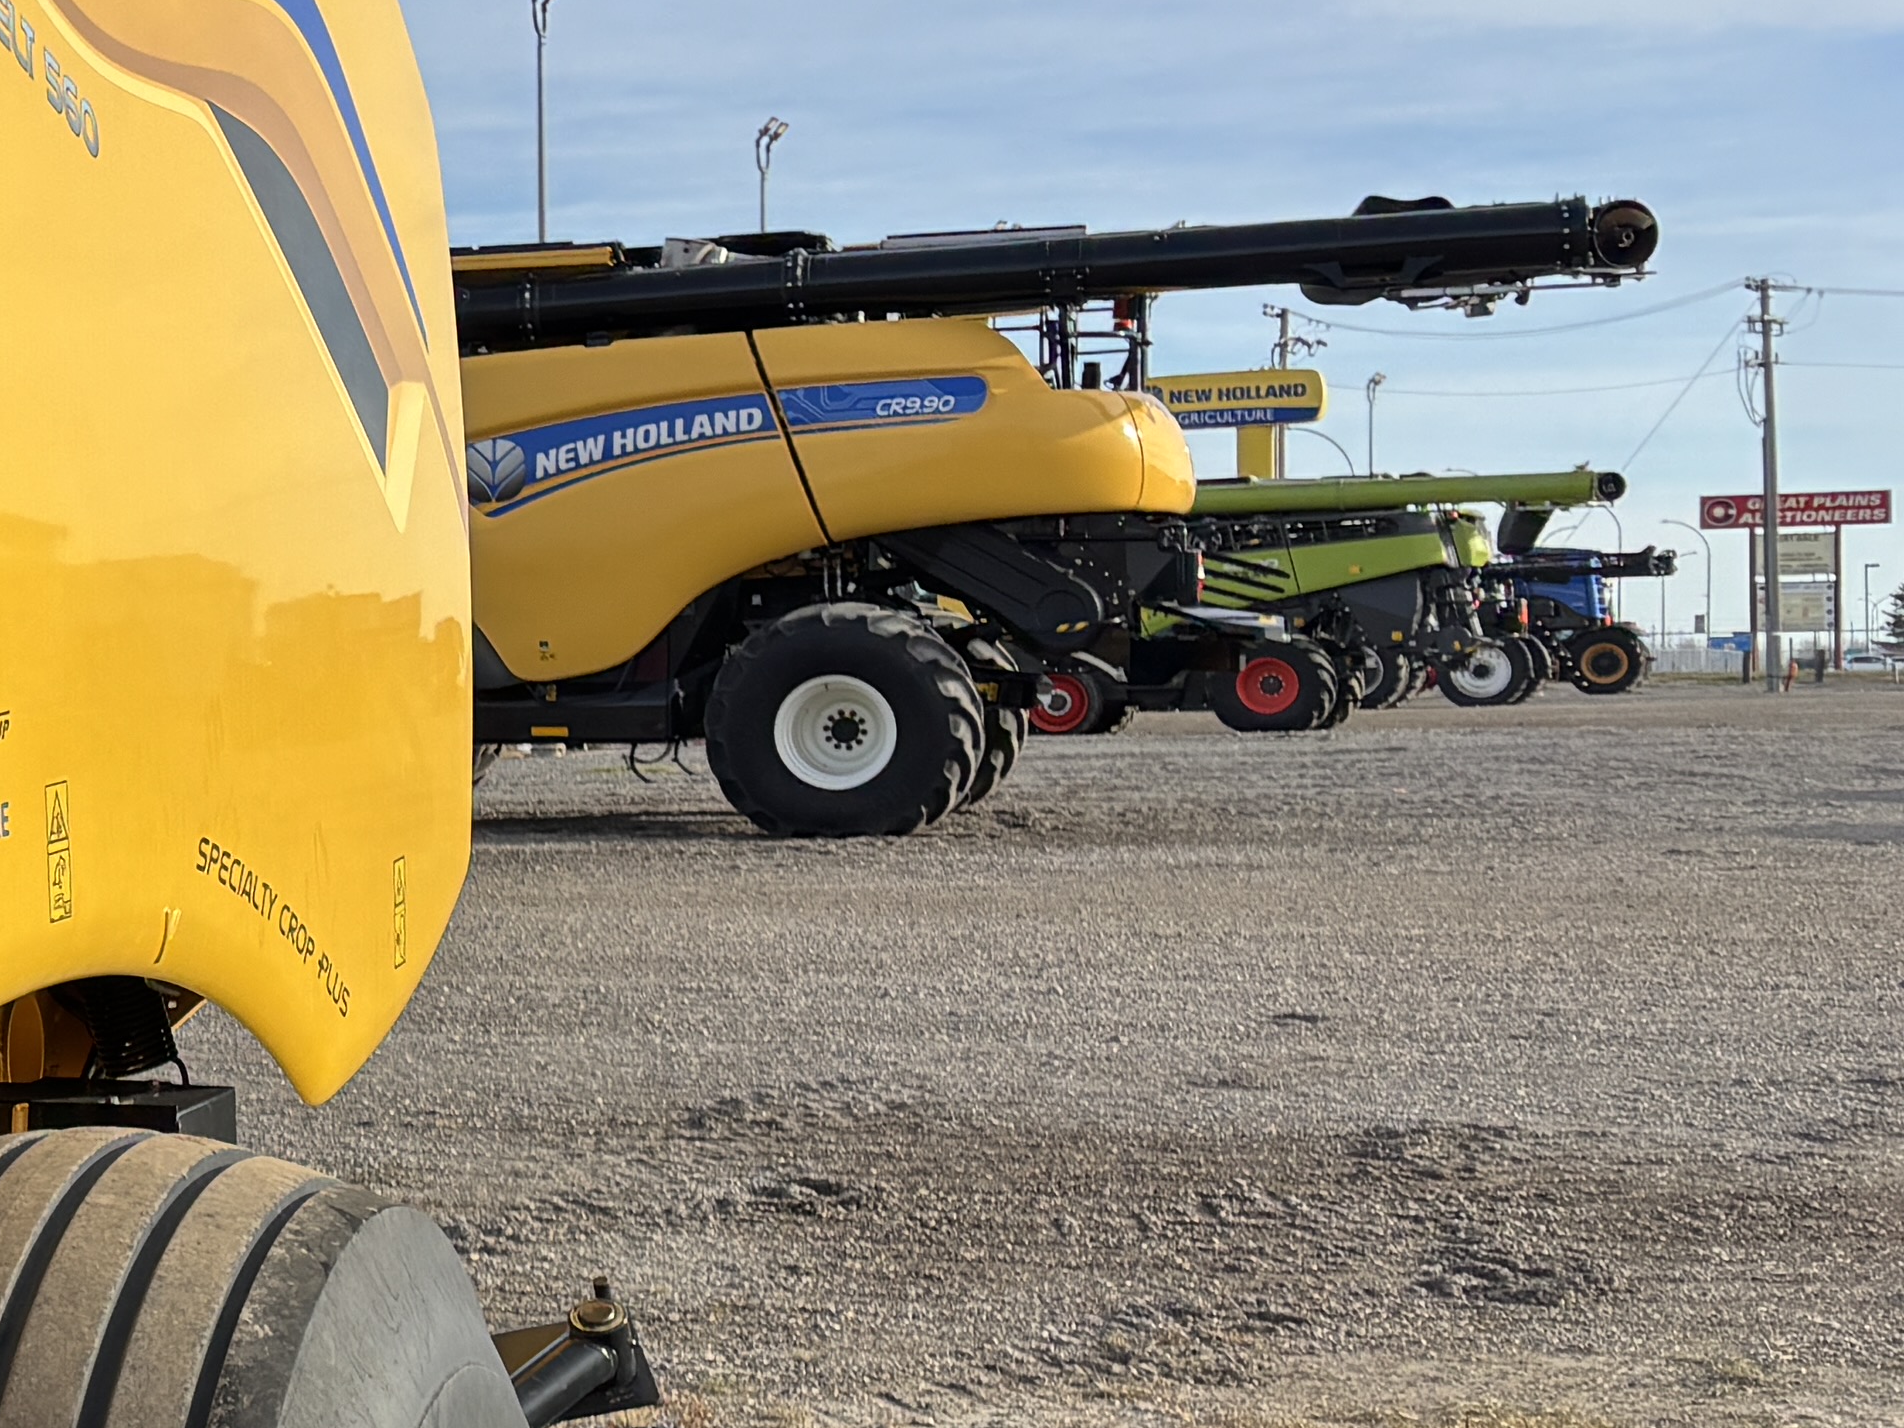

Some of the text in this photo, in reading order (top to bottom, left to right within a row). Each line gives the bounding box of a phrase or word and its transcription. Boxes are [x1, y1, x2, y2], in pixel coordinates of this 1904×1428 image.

[43, 46, 99, 159] 560
[1169, 383, 1307, 404] NEW HOLLAND
[875, 395, 955, 416] CR9.90
[1178, 409, 1275, 425] GRICULTURE
[535, 407, 763, 479] NEW HOLLAND
[1747, 494, 1881, 509] GEAT PLAINS
[196, 837, 351, 1017] SPECIALTY CROP PLUS
